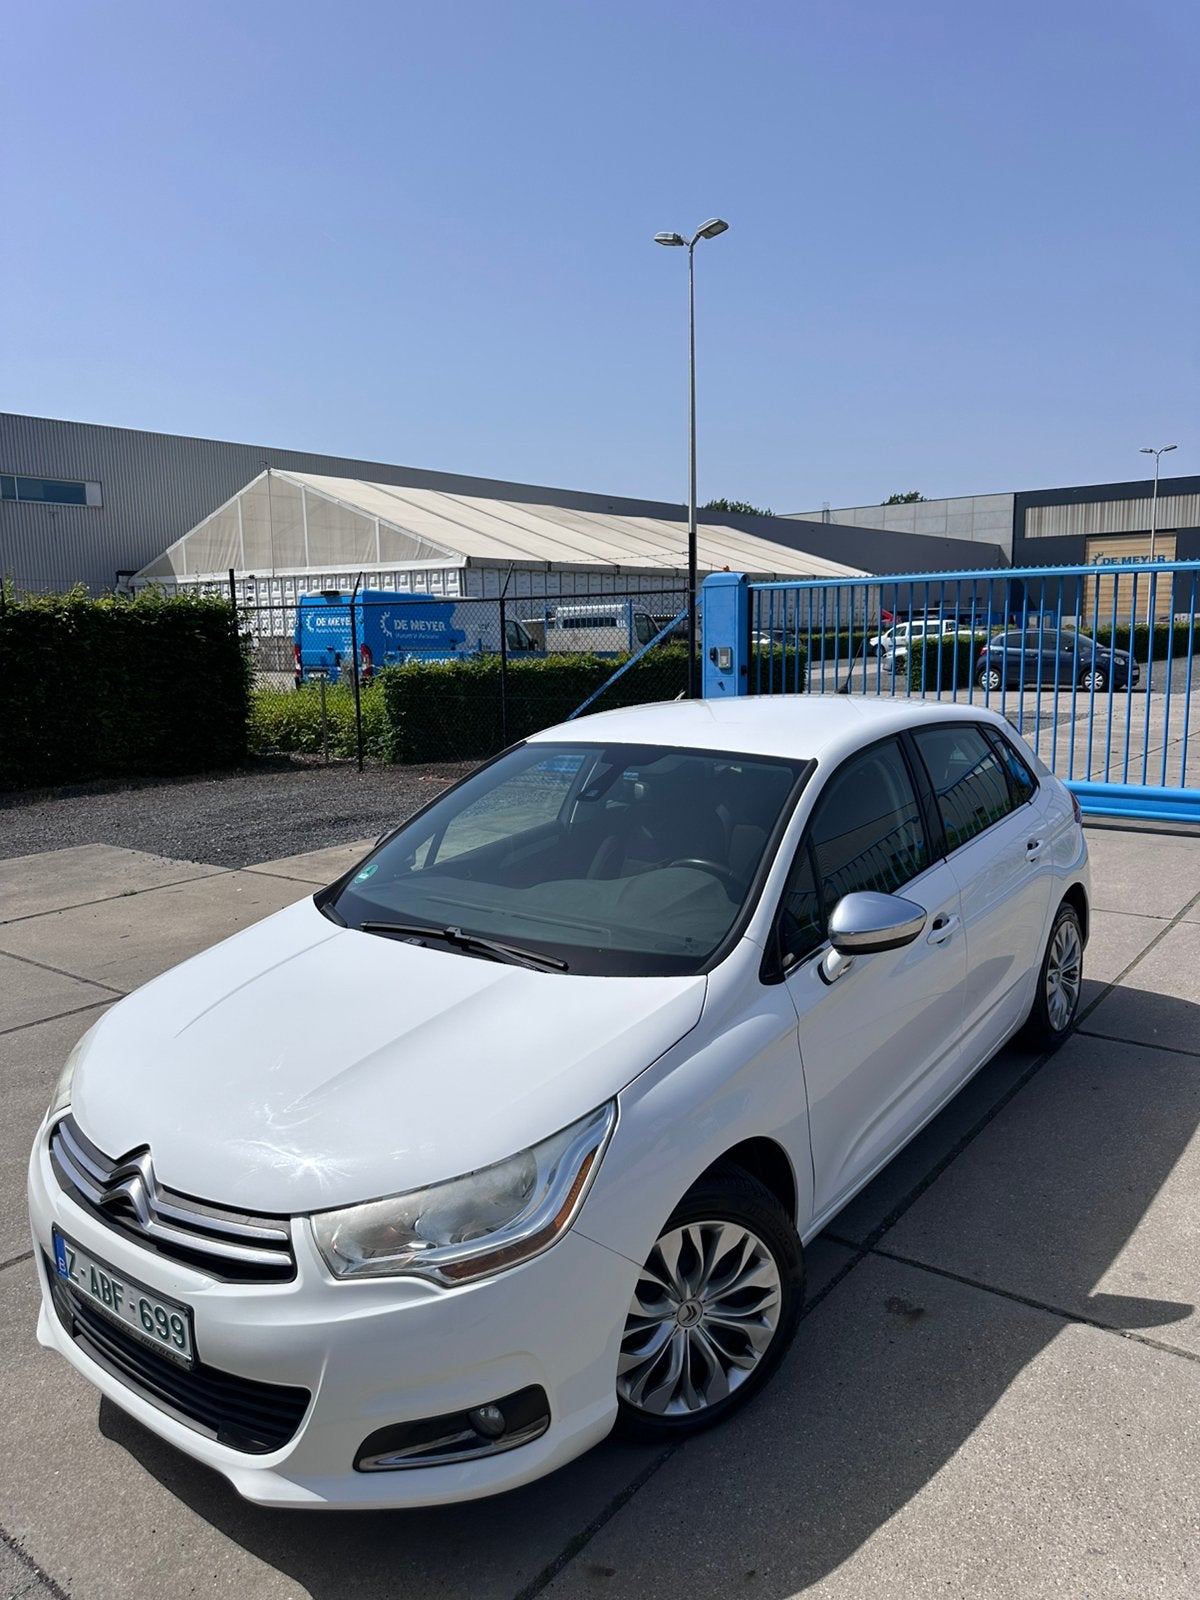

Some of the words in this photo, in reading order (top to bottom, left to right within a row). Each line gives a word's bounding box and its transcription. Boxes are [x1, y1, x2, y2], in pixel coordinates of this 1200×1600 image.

[1102, 556, 1118, 565] DE
[1121, 554, 1166, 565] MEYER
[315, 617, 326, 626] DE
[394, 619, 408, 631] DE
[410, 619, 446, 632] MEYER
[65, 1245, 186, 1349] Z-ABF-699
